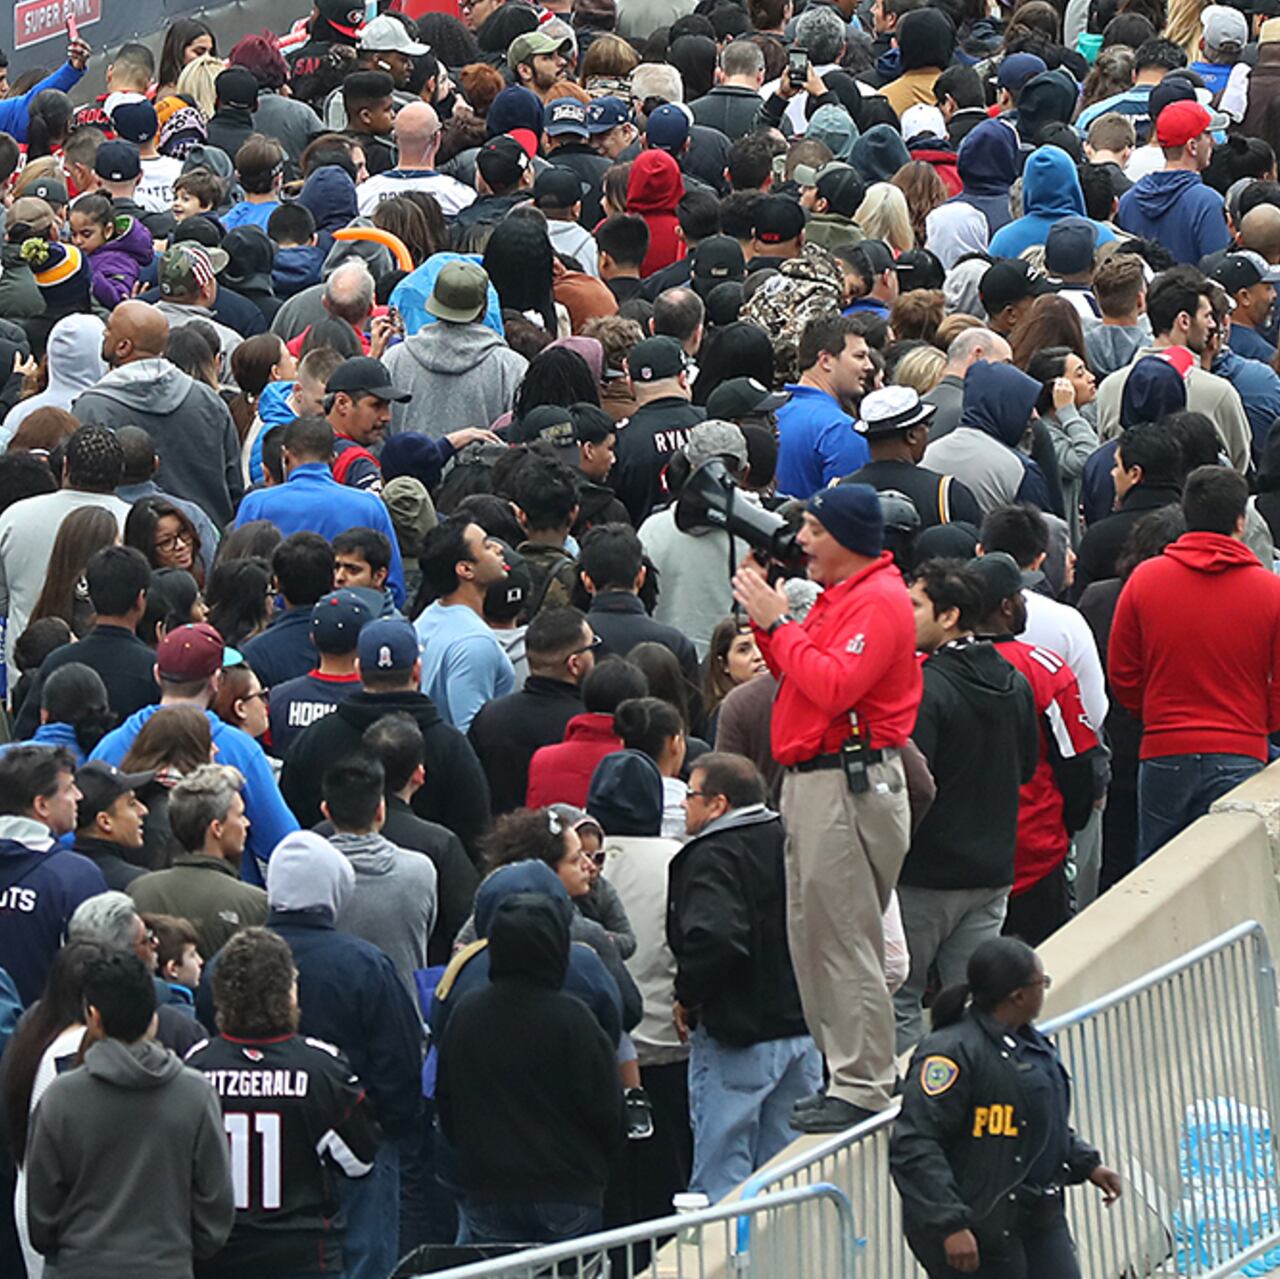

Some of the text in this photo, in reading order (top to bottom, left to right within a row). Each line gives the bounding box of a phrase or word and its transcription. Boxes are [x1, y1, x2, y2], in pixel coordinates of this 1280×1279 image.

[24, 6, 60, 35] SUPER
[973, 1104, 1019, 1137] POL
[224, 1112, 281, 1210] 11
